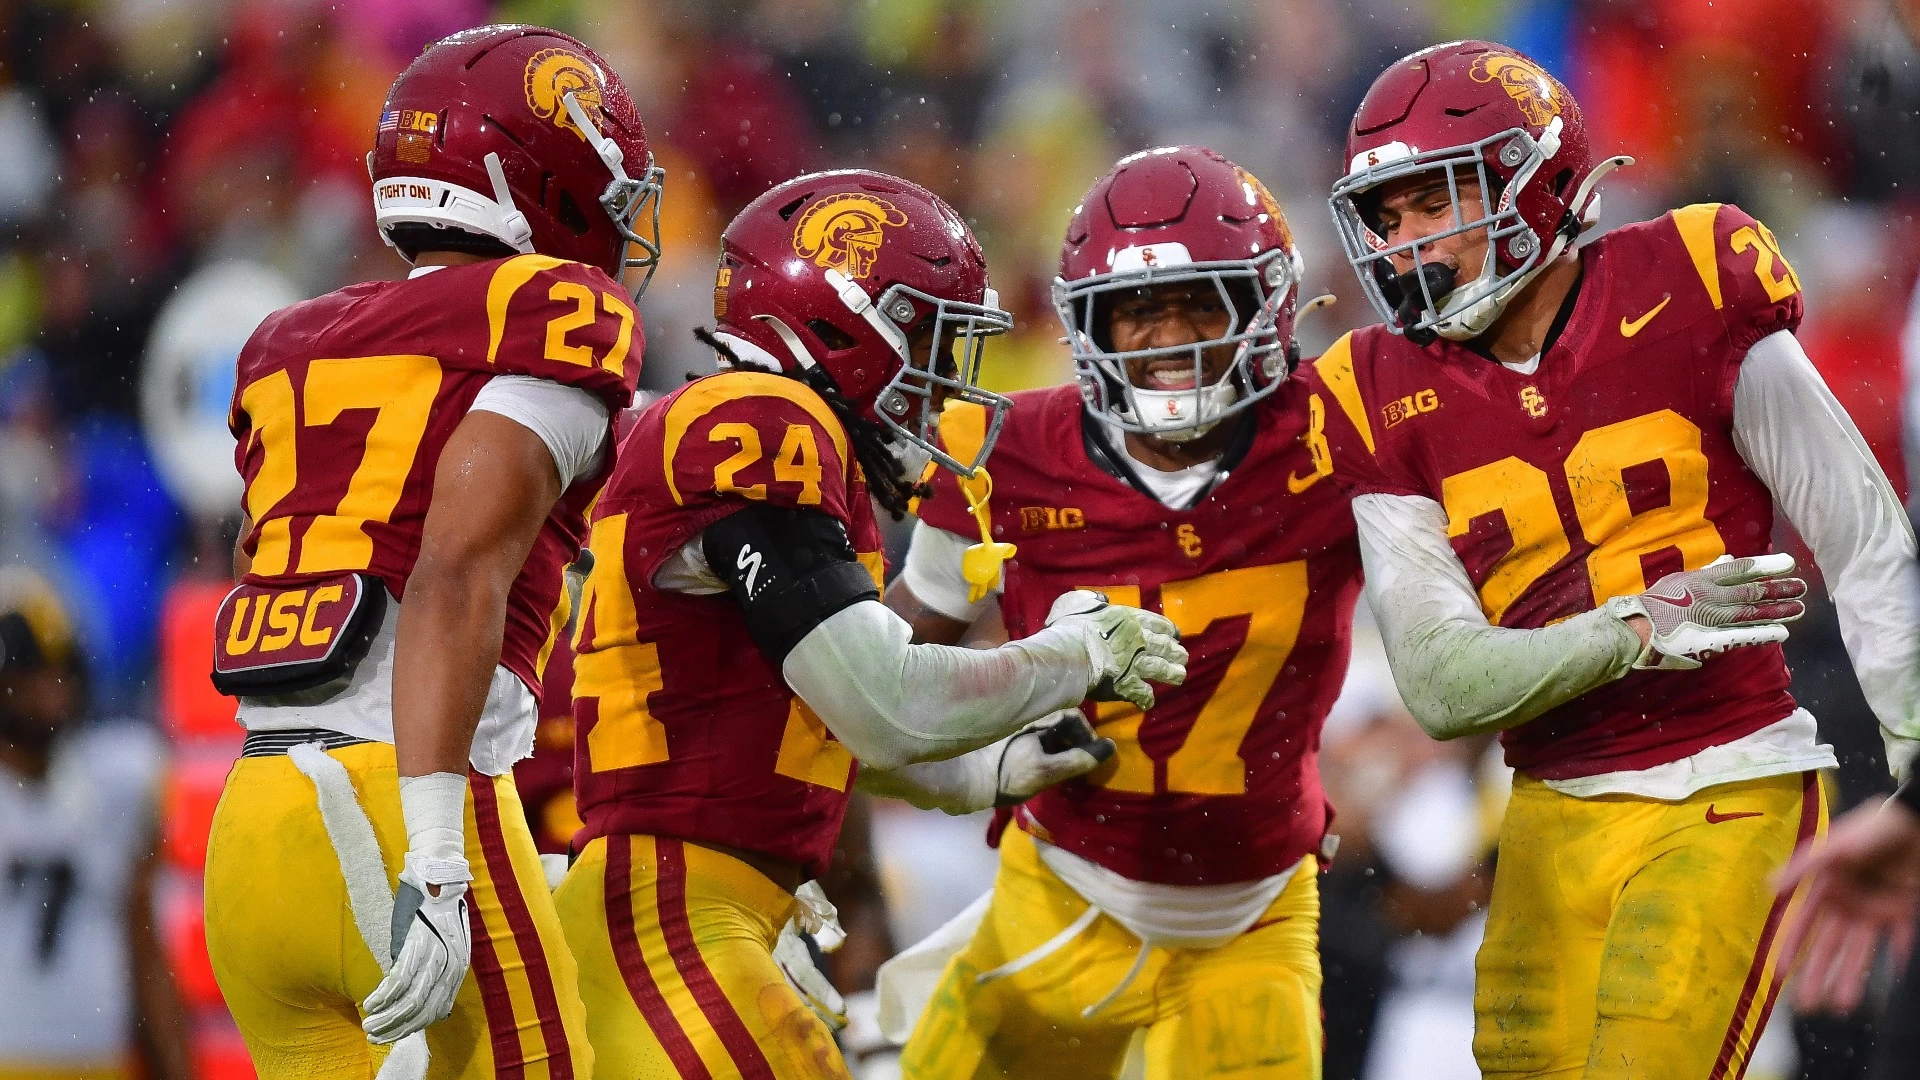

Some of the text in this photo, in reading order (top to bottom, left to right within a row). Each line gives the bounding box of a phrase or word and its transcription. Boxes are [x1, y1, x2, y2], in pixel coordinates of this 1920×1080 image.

[400, 110, 438, 134] BIG
[380, 184, 432, 201] FIGHT ON!
[544, 281, 635, 379] 27
[1382, 388, 1440, 430] BIG
[239, 354, 443, 576] 27
[708, 421, 823, 506] 24
[1020, 506, 1085, 531] BIG
[1441, 408, 1727, 628] 28
[225, 584, 344, 657] USC
[571, 513, 670, 774] 4
[1075, 559, 1310, 797] 17
